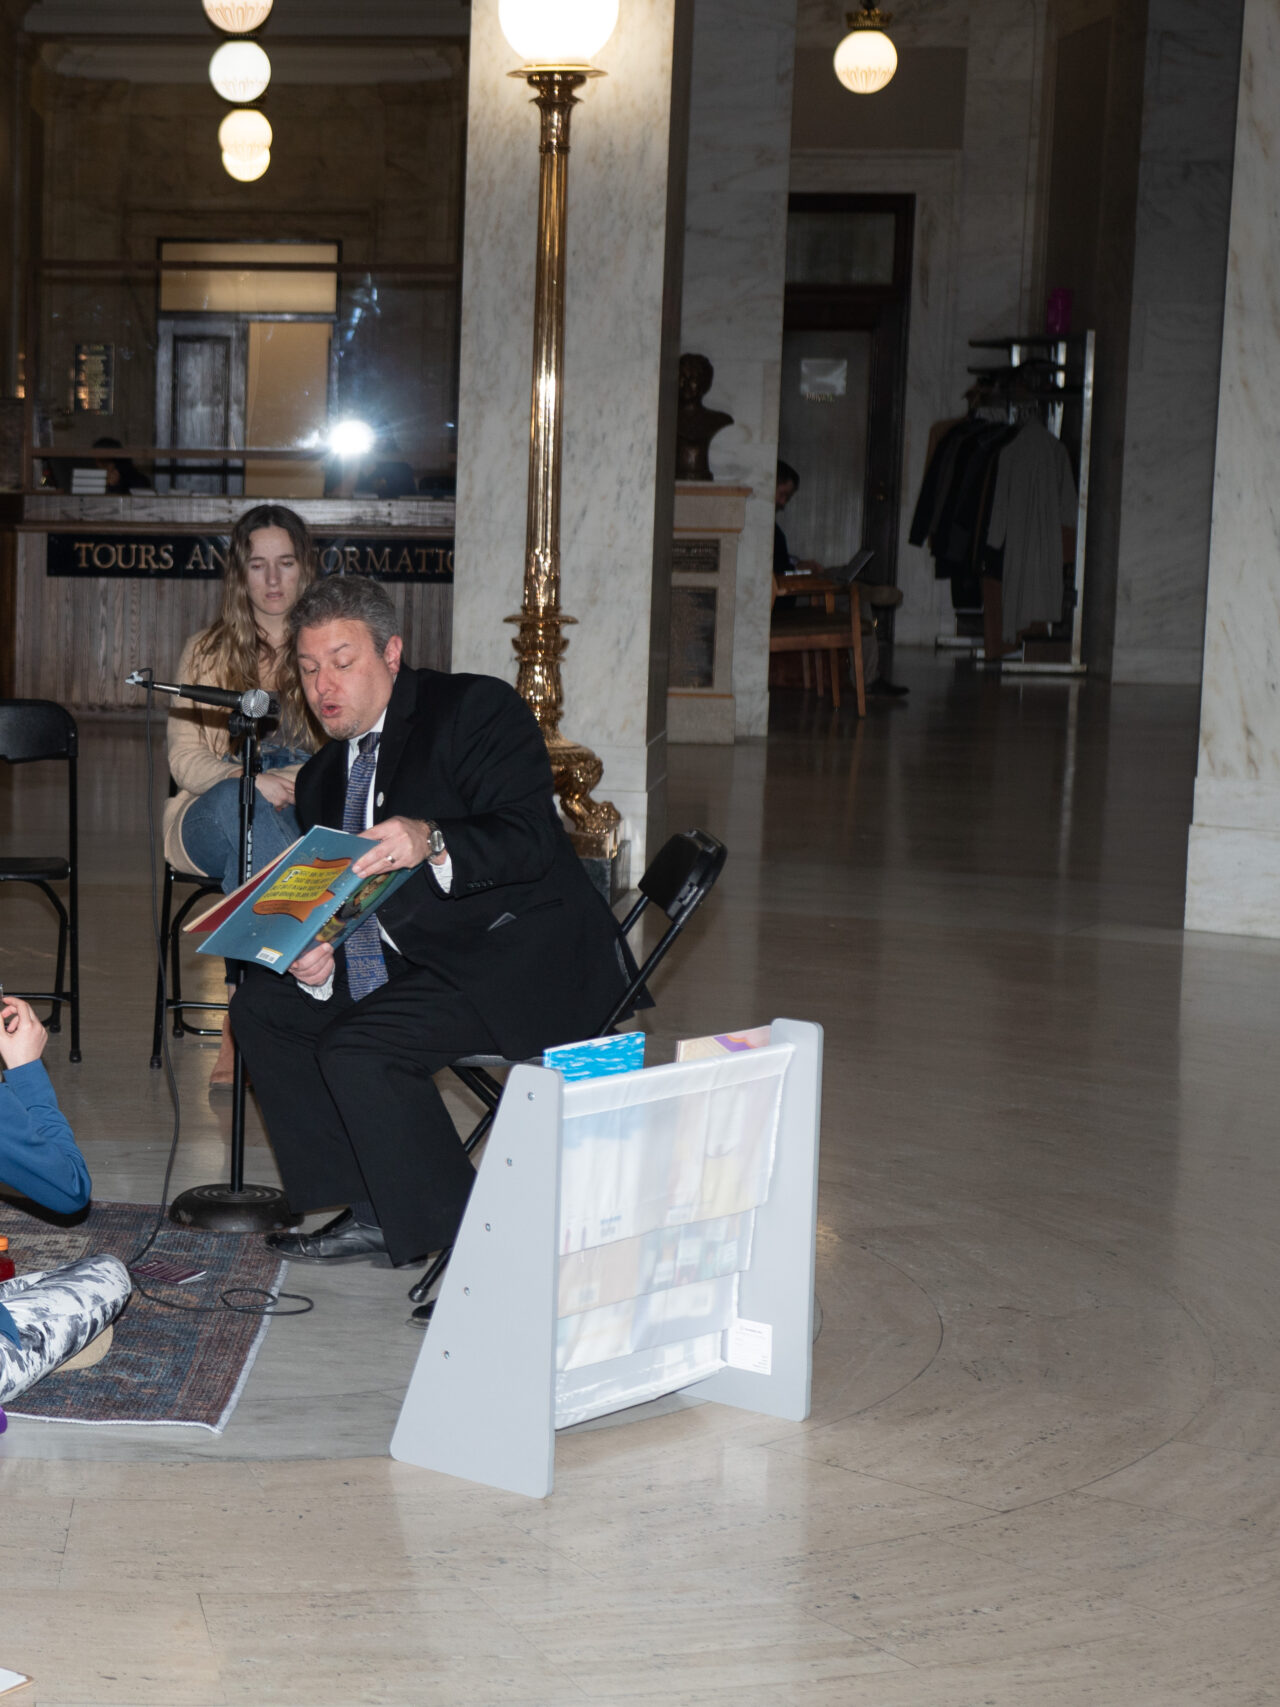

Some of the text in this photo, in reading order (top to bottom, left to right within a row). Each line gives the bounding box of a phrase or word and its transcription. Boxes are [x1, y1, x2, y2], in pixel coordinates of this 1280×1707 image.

[74, 543, 455, 574] TOURS AN ORMATI
